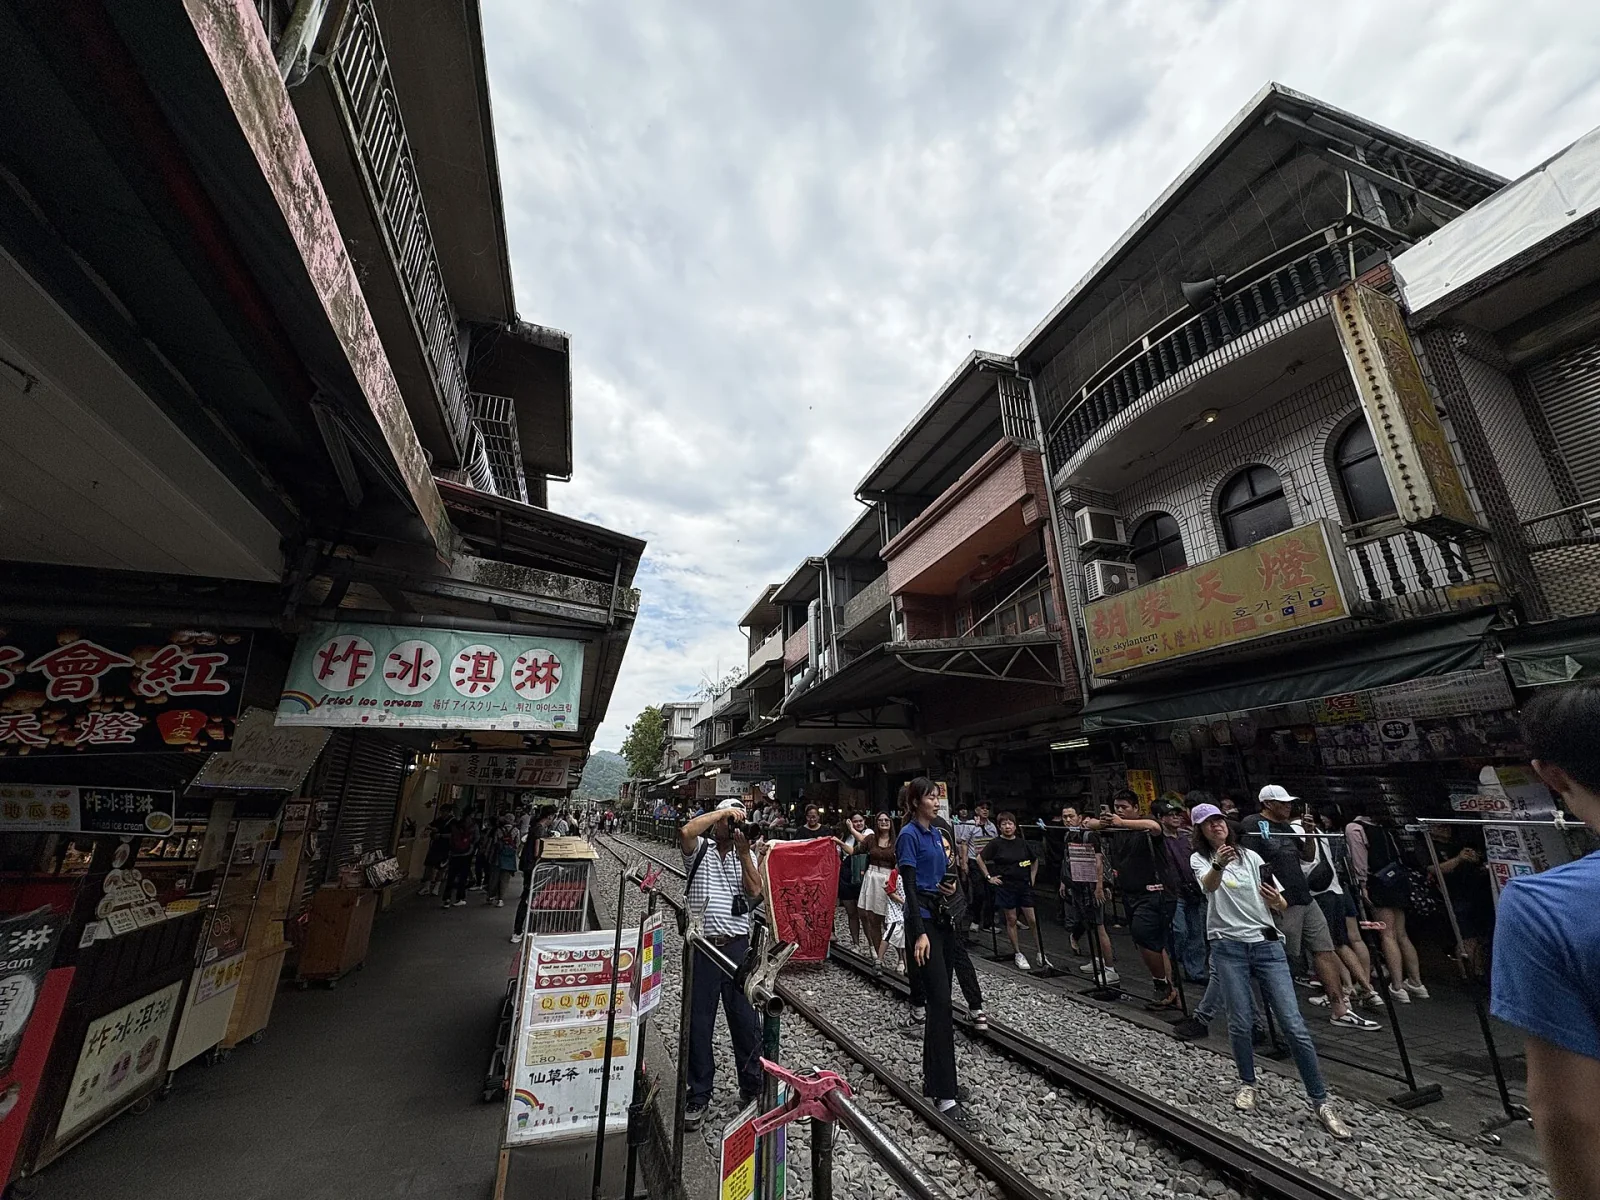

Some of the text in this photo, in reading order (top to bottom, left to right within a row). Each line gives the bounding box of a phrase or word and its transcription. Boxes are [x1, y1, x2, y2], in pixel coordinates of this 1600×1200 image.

[1091, 537, 1320, 638] 胡家天燈
[1113, 632, 1159, 652] skylantern
[318, 640, 561, 694] 炸冰淇淋
[317, 694, 424, 708] fried ice cream
[536, 702, 573, 713] 아이스크림
[171, 710, 192, 737] 平安
[468, 755, 518, 767] 冬瓜茶
[84, 791, 154, 813] 炸冰淇淋
[122, 822, 145, 832] cream
[86, 999, 171, 1057] 炸冰淇淋
[539, 1055, 556, 1063] 80
[528, 1067, 580, 1086] 仙草茶
[588, 1066, 608, 1075] Herb
